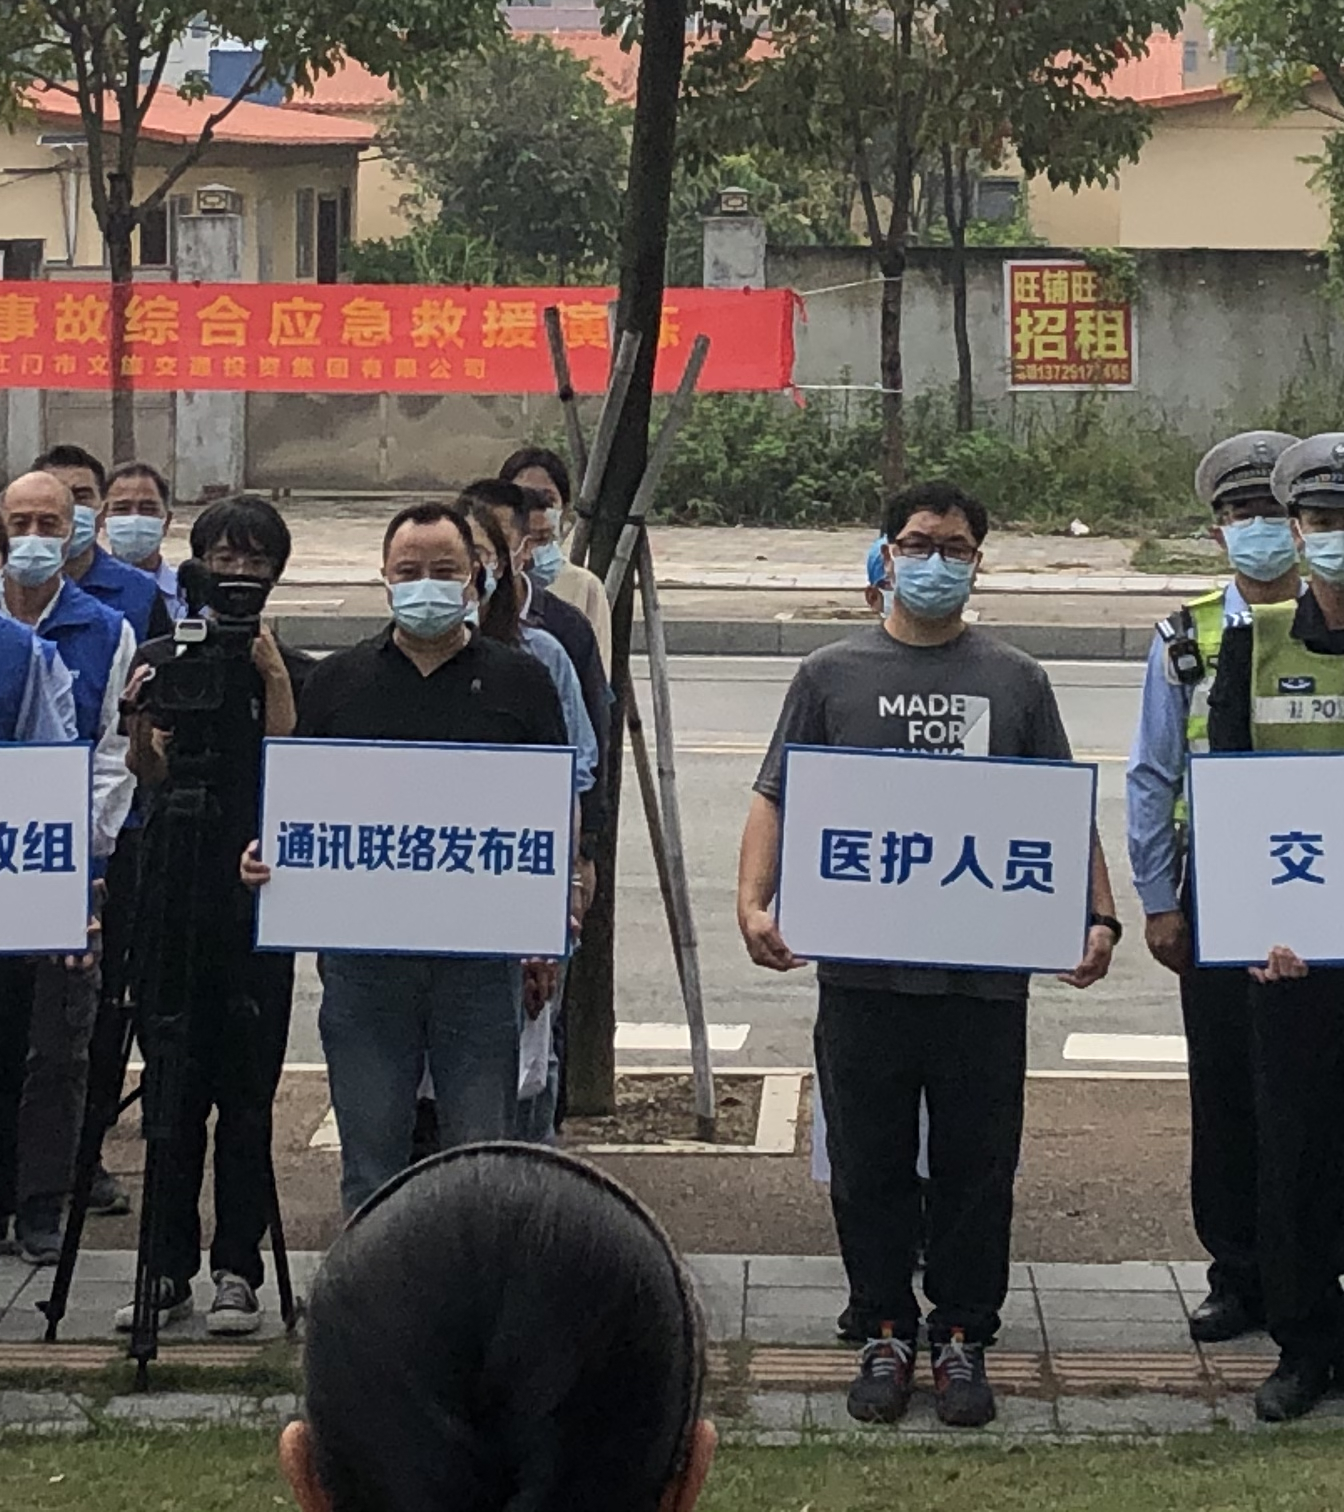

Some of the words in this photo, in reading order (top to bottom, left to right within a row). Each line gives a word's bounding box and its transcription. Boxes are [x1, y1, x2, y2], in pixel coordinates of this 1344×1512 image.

[1014, 308, 1128, 360] 招租
[879, 694, 965, 717] MADE
[908, 720, 964, 744] FOR
[275, 821, 556, 876] 通讯联络发布组
[819, 828, 1055, 894] 医护人员
